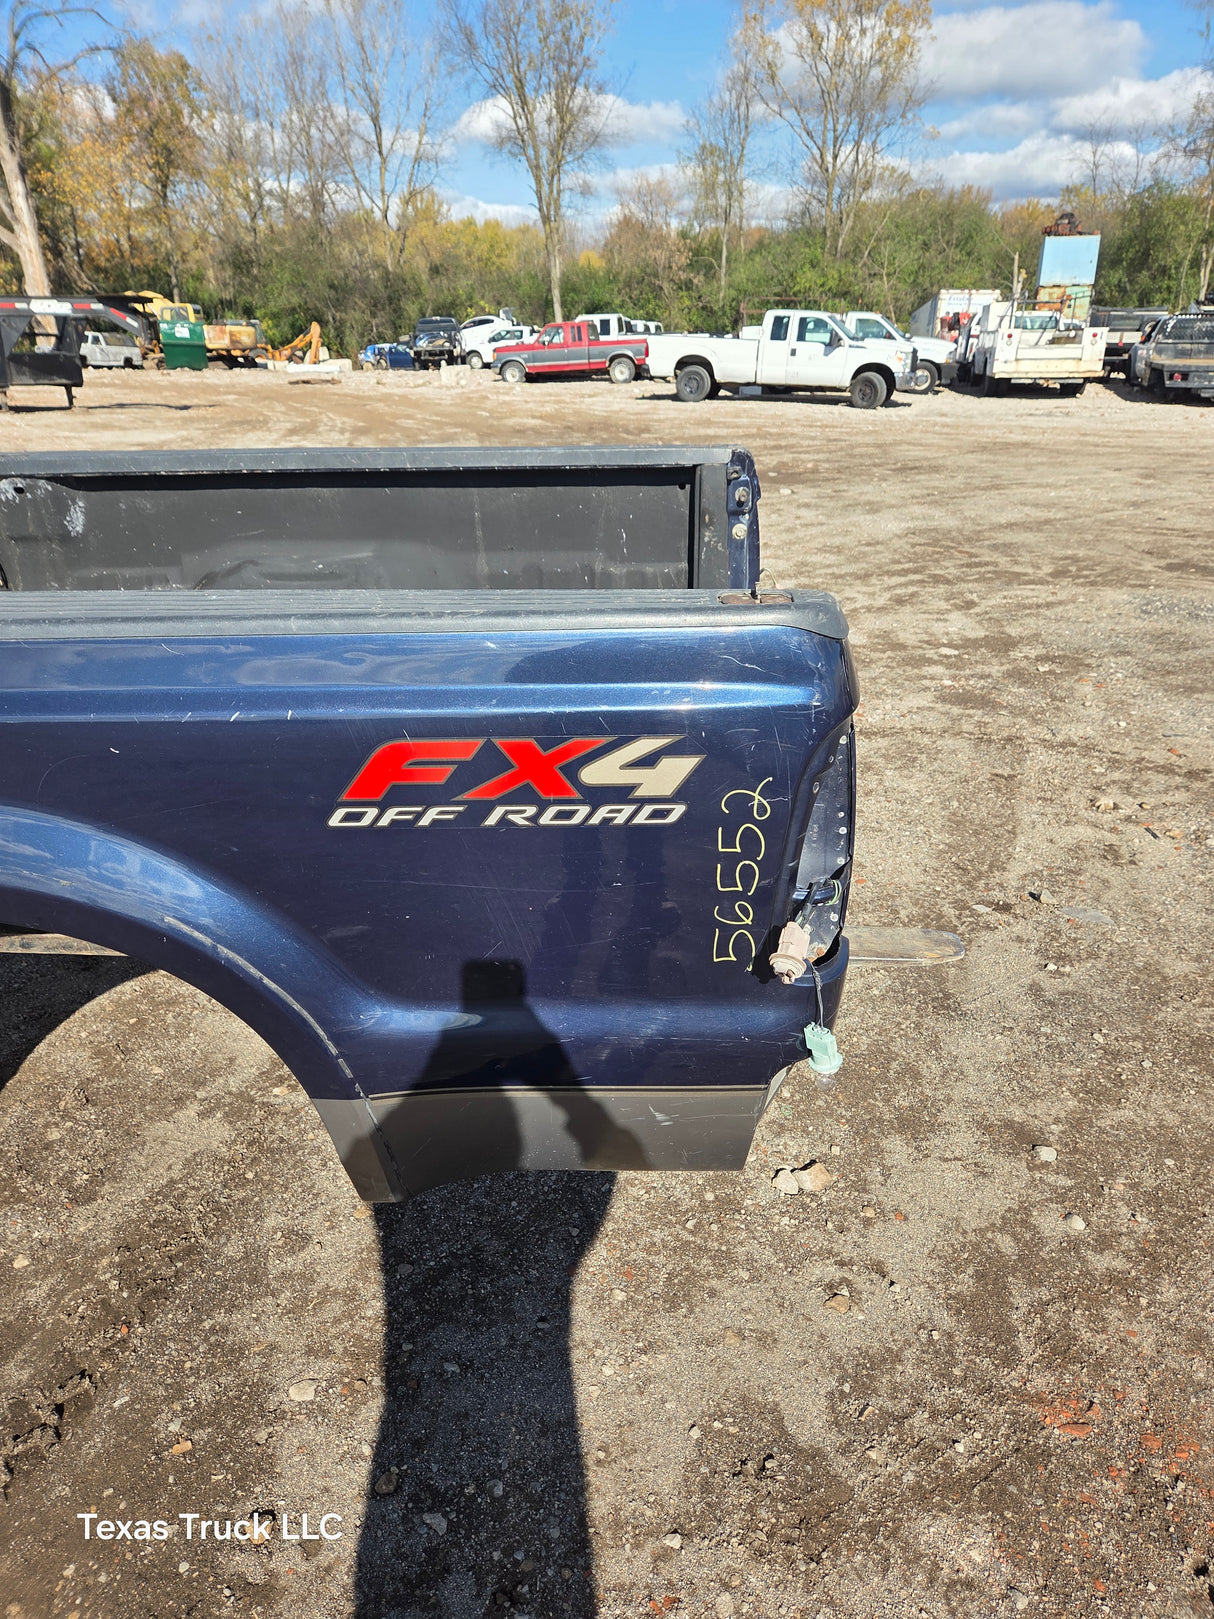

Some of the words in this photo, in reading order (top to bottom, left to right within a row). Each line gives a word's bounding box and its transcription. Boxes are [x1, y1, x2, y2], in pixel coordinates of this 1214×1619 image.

[338, 736, 707, 800] FX4
[327, 805, 467, 828] OFF
[481, 804, 689, 827] ROAD
[713, 776, 774, 972] 56552
